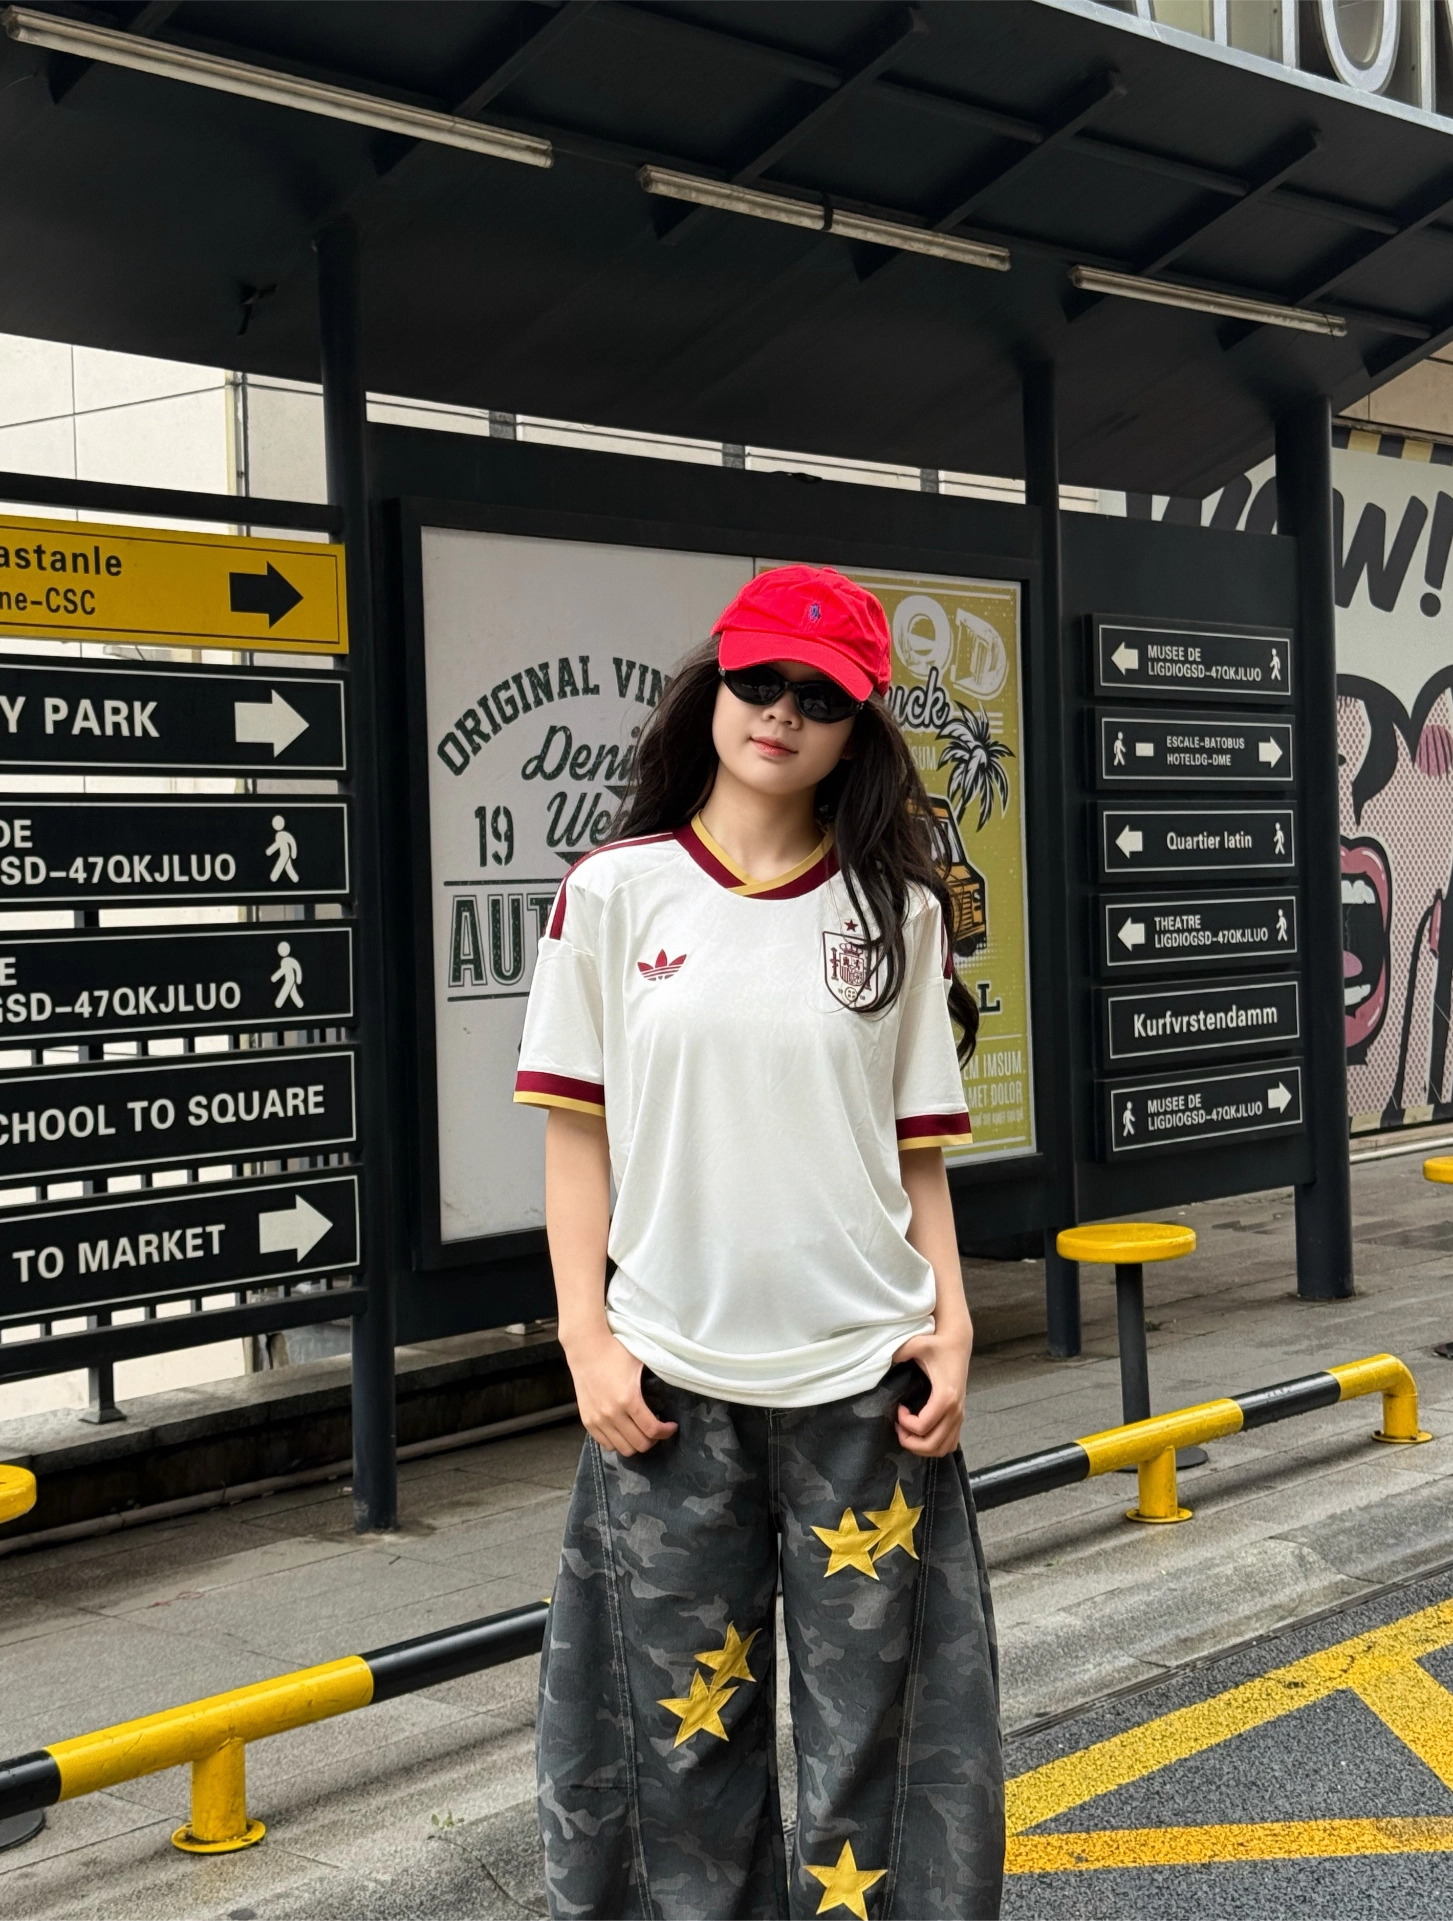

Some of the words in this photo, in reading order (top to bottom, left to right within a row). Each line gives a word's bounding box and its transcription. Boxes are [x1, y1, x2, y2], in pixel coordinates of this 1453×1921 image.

[0, 544, 122, 577] astanle
[0, 587, 96, 616] ne-CSC
[1147, 645, 1185, 662] MUSEE
[1187, 647, 1202, 662] DE
[1148, 662, 1262, 682] LIGDIOGSD-47QKJLUO
[0, 695, 27, 734] Y
[44, 697, 160, 738] PARK
[436, 655, 600, 776] ORIGINAL
[1166, 736, 1245, 749] ESCALE-BATOBUS
[1166, 754, 1232, 766] HOTELDG-DME
[546, 791, 632, 848] We
[474, 804, 514, 868] 19
[1166, 832, 1221, 850] Quartier
[1224, 831, 1253, 849] latin
[0, 853, 236, 885] SD-47QKJLUO
[1154, 914, 1202, 931] THEATRE
[1154, 927, 1269, 949] LIGDIOGSD-47QKJLUO
[0, 981, 241, 1023] SD-47QKJLUO
[1133, 1004, 1278, 1038] Kurfvrstendamm
[127, 1098, 175, 1132] TO
[188, 1085, 325, 1127] SQUARE
[1147, 1096, 1185, 1115] MUSEE
[1187, 1093, 1202, 1109] DE
[1148, 1101, 1263, 1131] LIGDIOGSD-47QKJLUO
[12, 1246, 64, 1283] TO
[78, 1224, 226, 1275] MARKET
